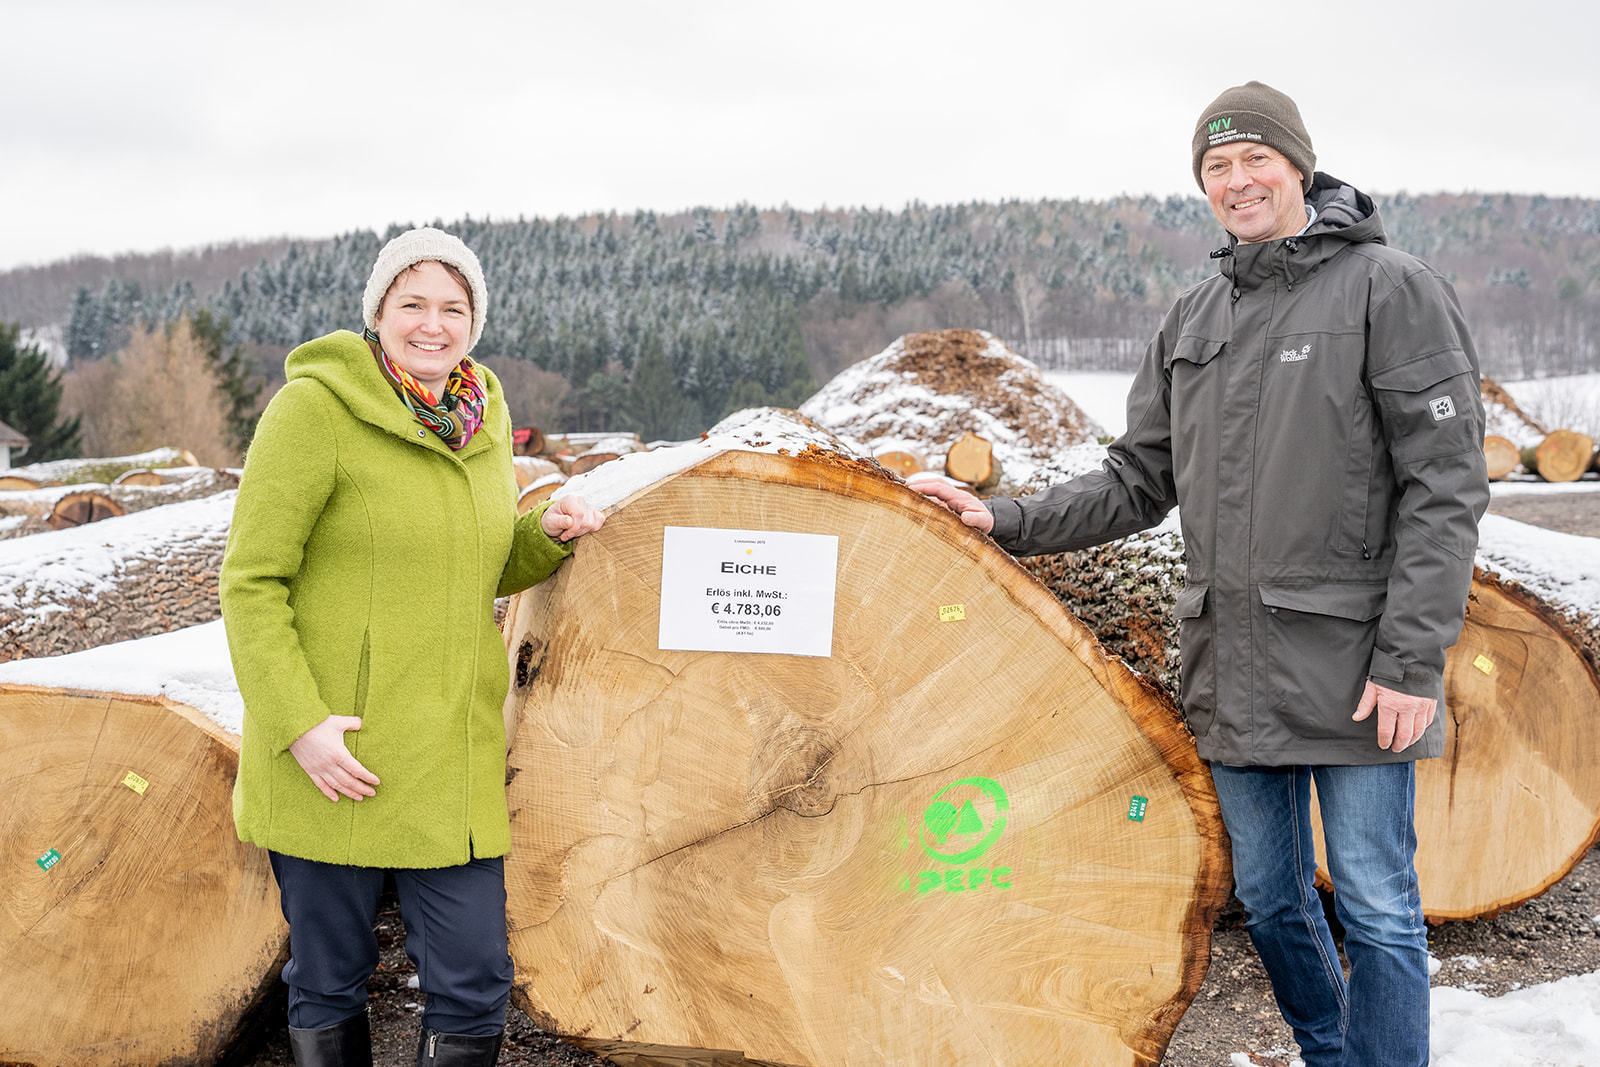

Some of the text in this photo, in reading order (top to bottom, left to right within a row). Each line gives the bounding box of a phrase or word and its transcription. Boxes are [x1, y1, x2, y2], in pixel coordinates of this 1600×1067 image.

[1208, 116, 1231, 133] WV
[1280, 353, 1308, 362] Wolfskin
[706, 588, 788, 600] Erlös inkl. MwSt.:
[711, 602, 781, 617] € 4.783,06
[918, 866, 1013, 893] PEFC
